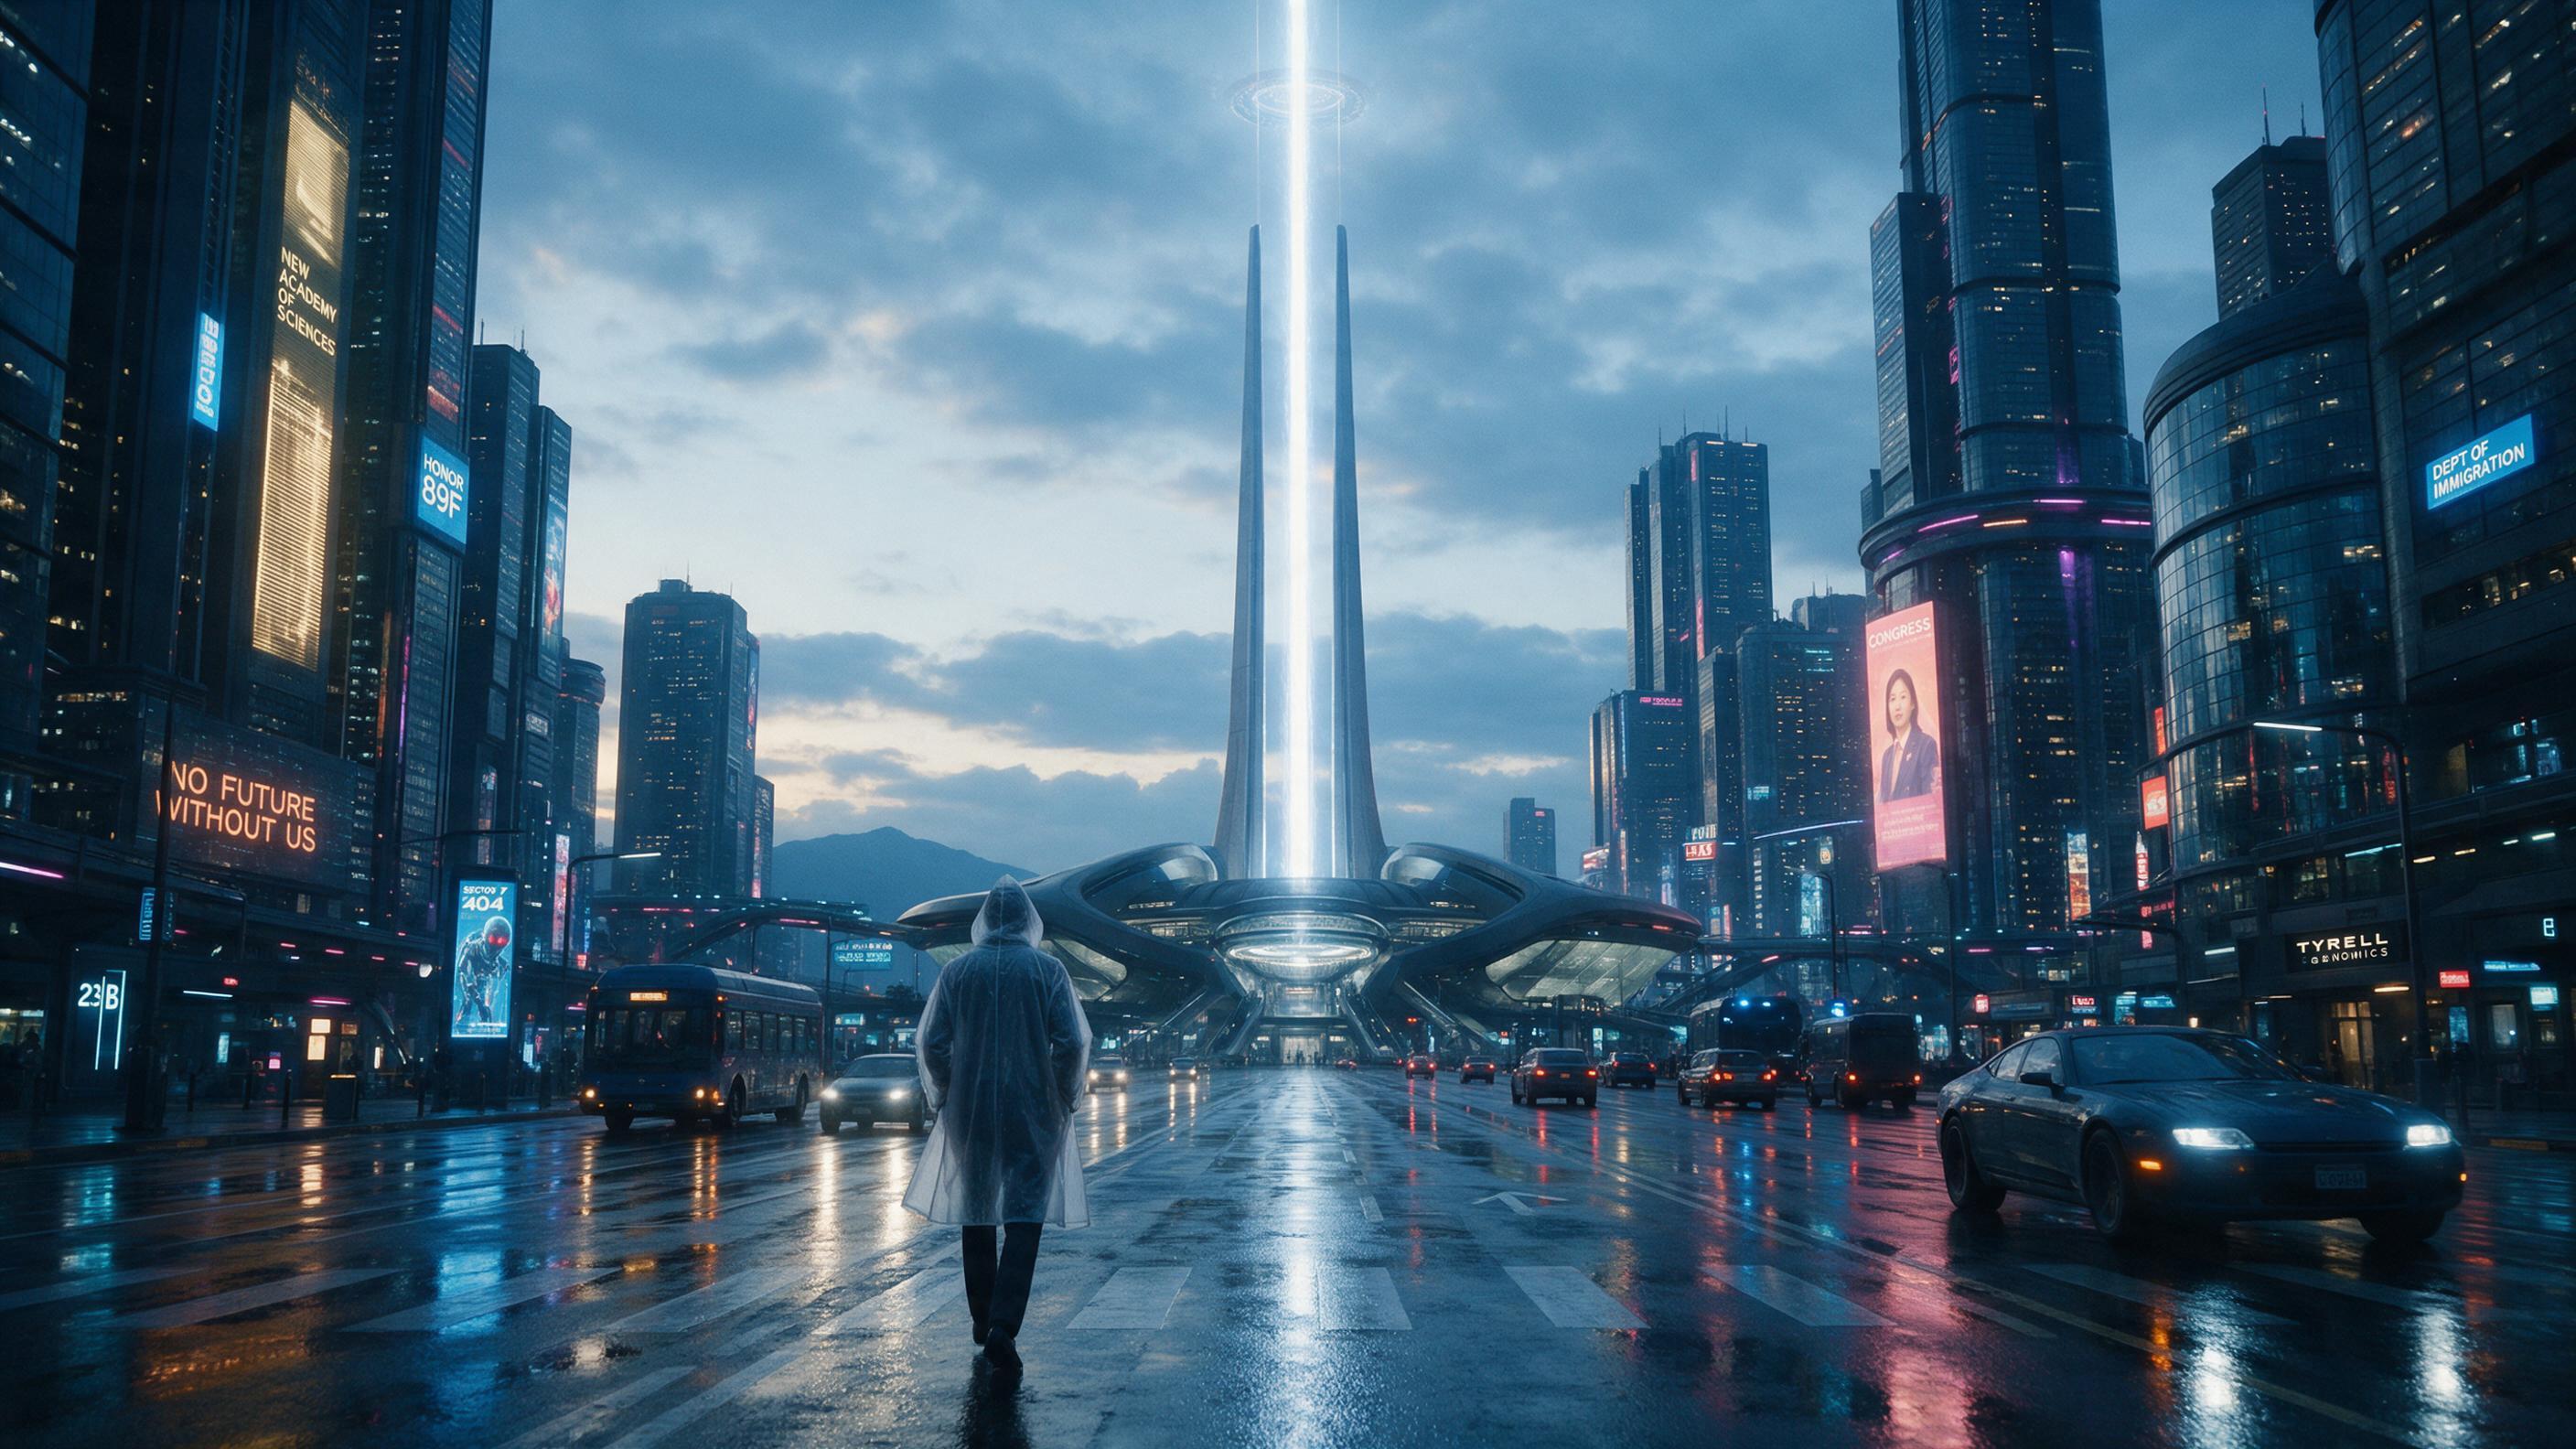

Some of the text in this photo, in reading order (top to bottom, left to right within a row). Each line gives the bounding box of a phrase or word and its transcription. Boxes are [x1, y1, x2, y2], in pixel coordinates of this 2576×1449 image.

[281, 246, 310, 280] NEW
[278, 287, 295, 306] OF
[279, 268, 337, 323] ACADEMY
[277, 305, 336, 356] SCIENCES
[424, 453, 464, 492] HONOR
[2433, 440, 2488, 481] DEPT OF
[2434, 442, 2525, 499] IMMIGRATION
[422, 475, 463, 519] 89F
[1869, 617, 1931, 648] CONGRESS
[171, 760, 316, 823] NO FUTURE
[156, 789, 317, 853] WITHOUT US
[461, 896, 505, 912] 404
[2296, 933, 2388, 953] TYRELL
